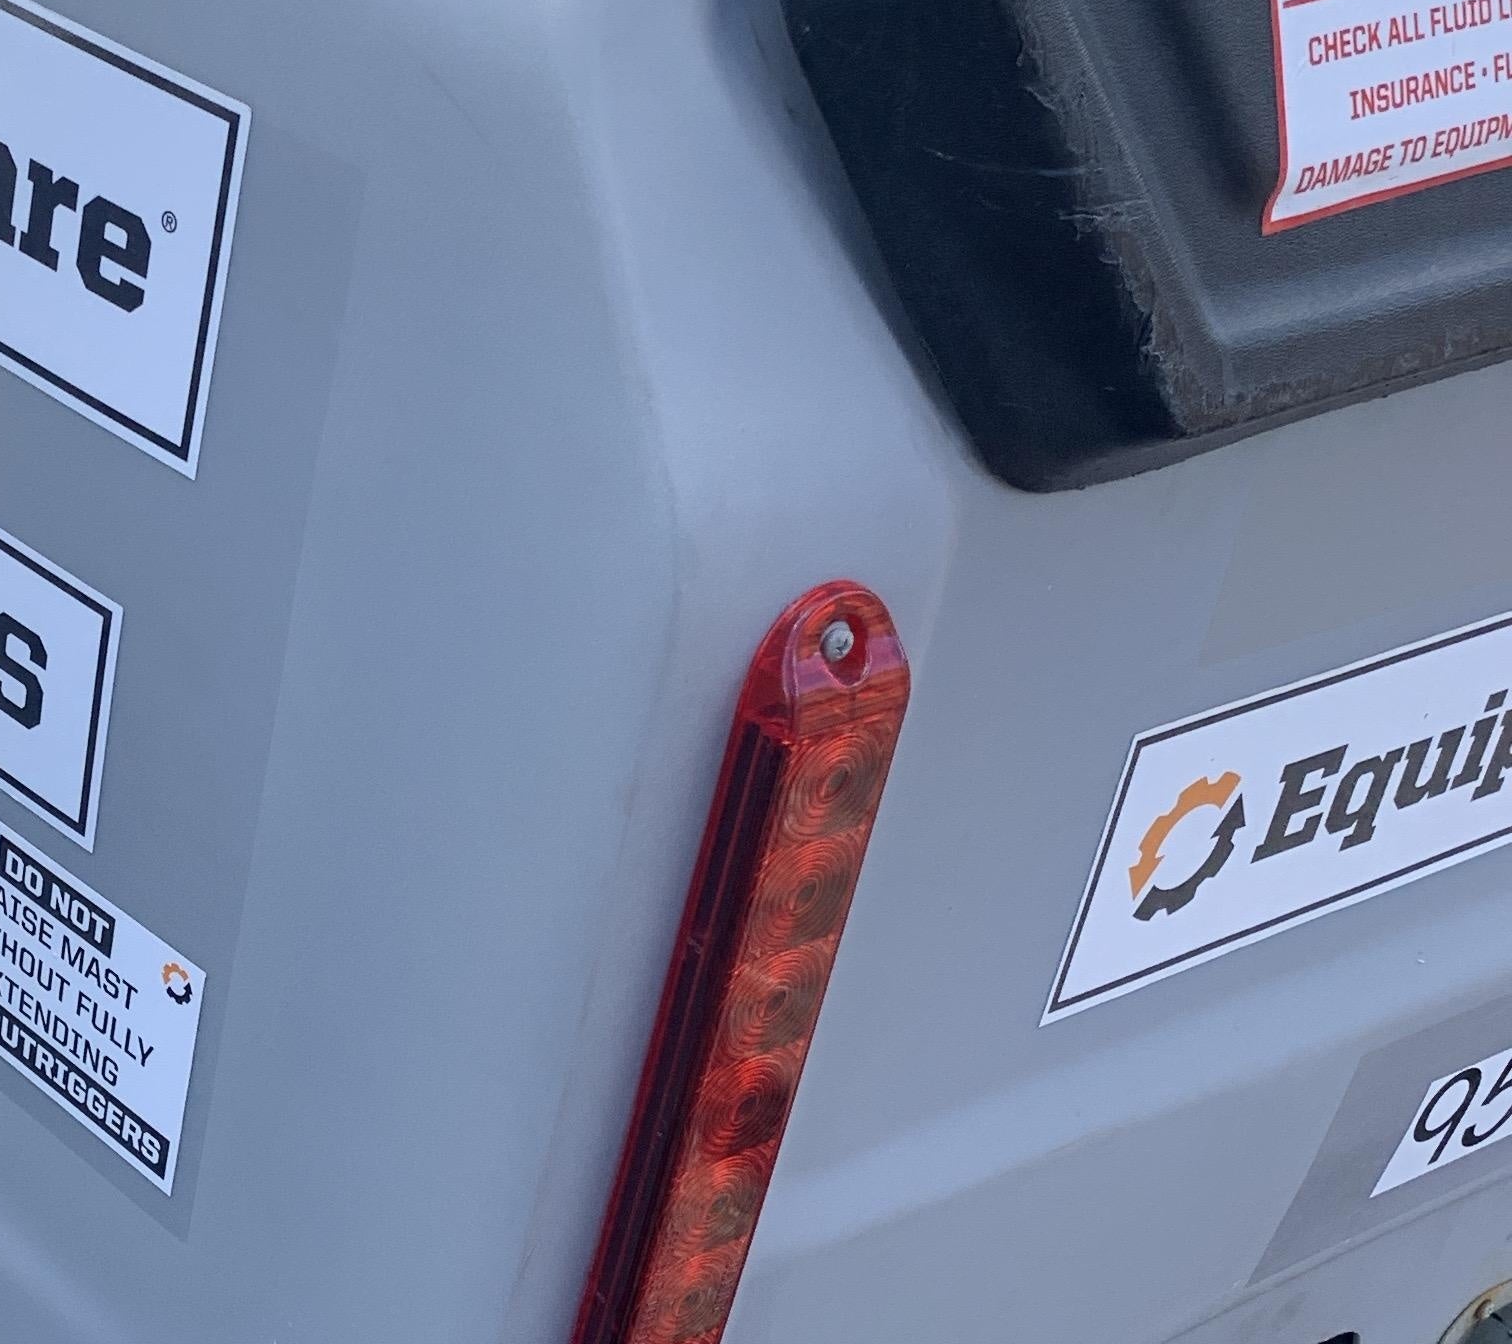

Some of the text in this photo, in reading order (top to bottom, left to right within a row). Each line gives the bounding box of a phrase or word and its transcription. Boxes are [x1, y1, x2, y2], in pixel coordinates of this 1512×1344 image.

[1308, 20, 1383, 67] CHECK
[1388, 10, 1426, 46] ALL
[1349, 60, 1476, 120] INSURANCE
[1294, 143, 1396, 195] DAMAGE
[1400, 135, 1427, 164] TO
[4, 848, 110, 944] DO NOT
[61, 939, 139, 1010] MAST
[76, 993, 154, 1068] FULLY
